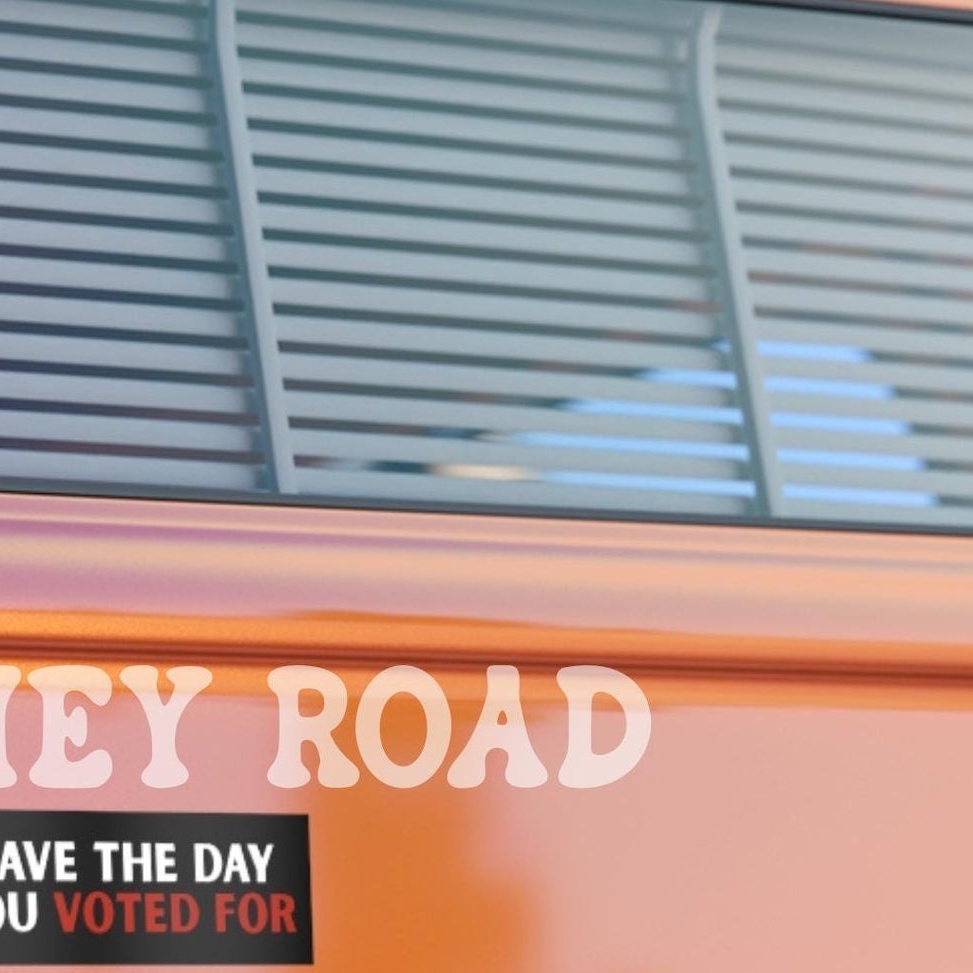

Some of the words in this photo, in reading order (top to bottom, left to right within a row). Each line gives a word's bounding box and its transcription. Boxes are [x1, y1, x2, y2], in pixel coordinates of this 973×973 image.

[93, 841, 178, 882] THE
[193, 843, 275, 884] DAY
[55, 892, 201, 934] VOTED
[214, 893, 298, 934] FOR
